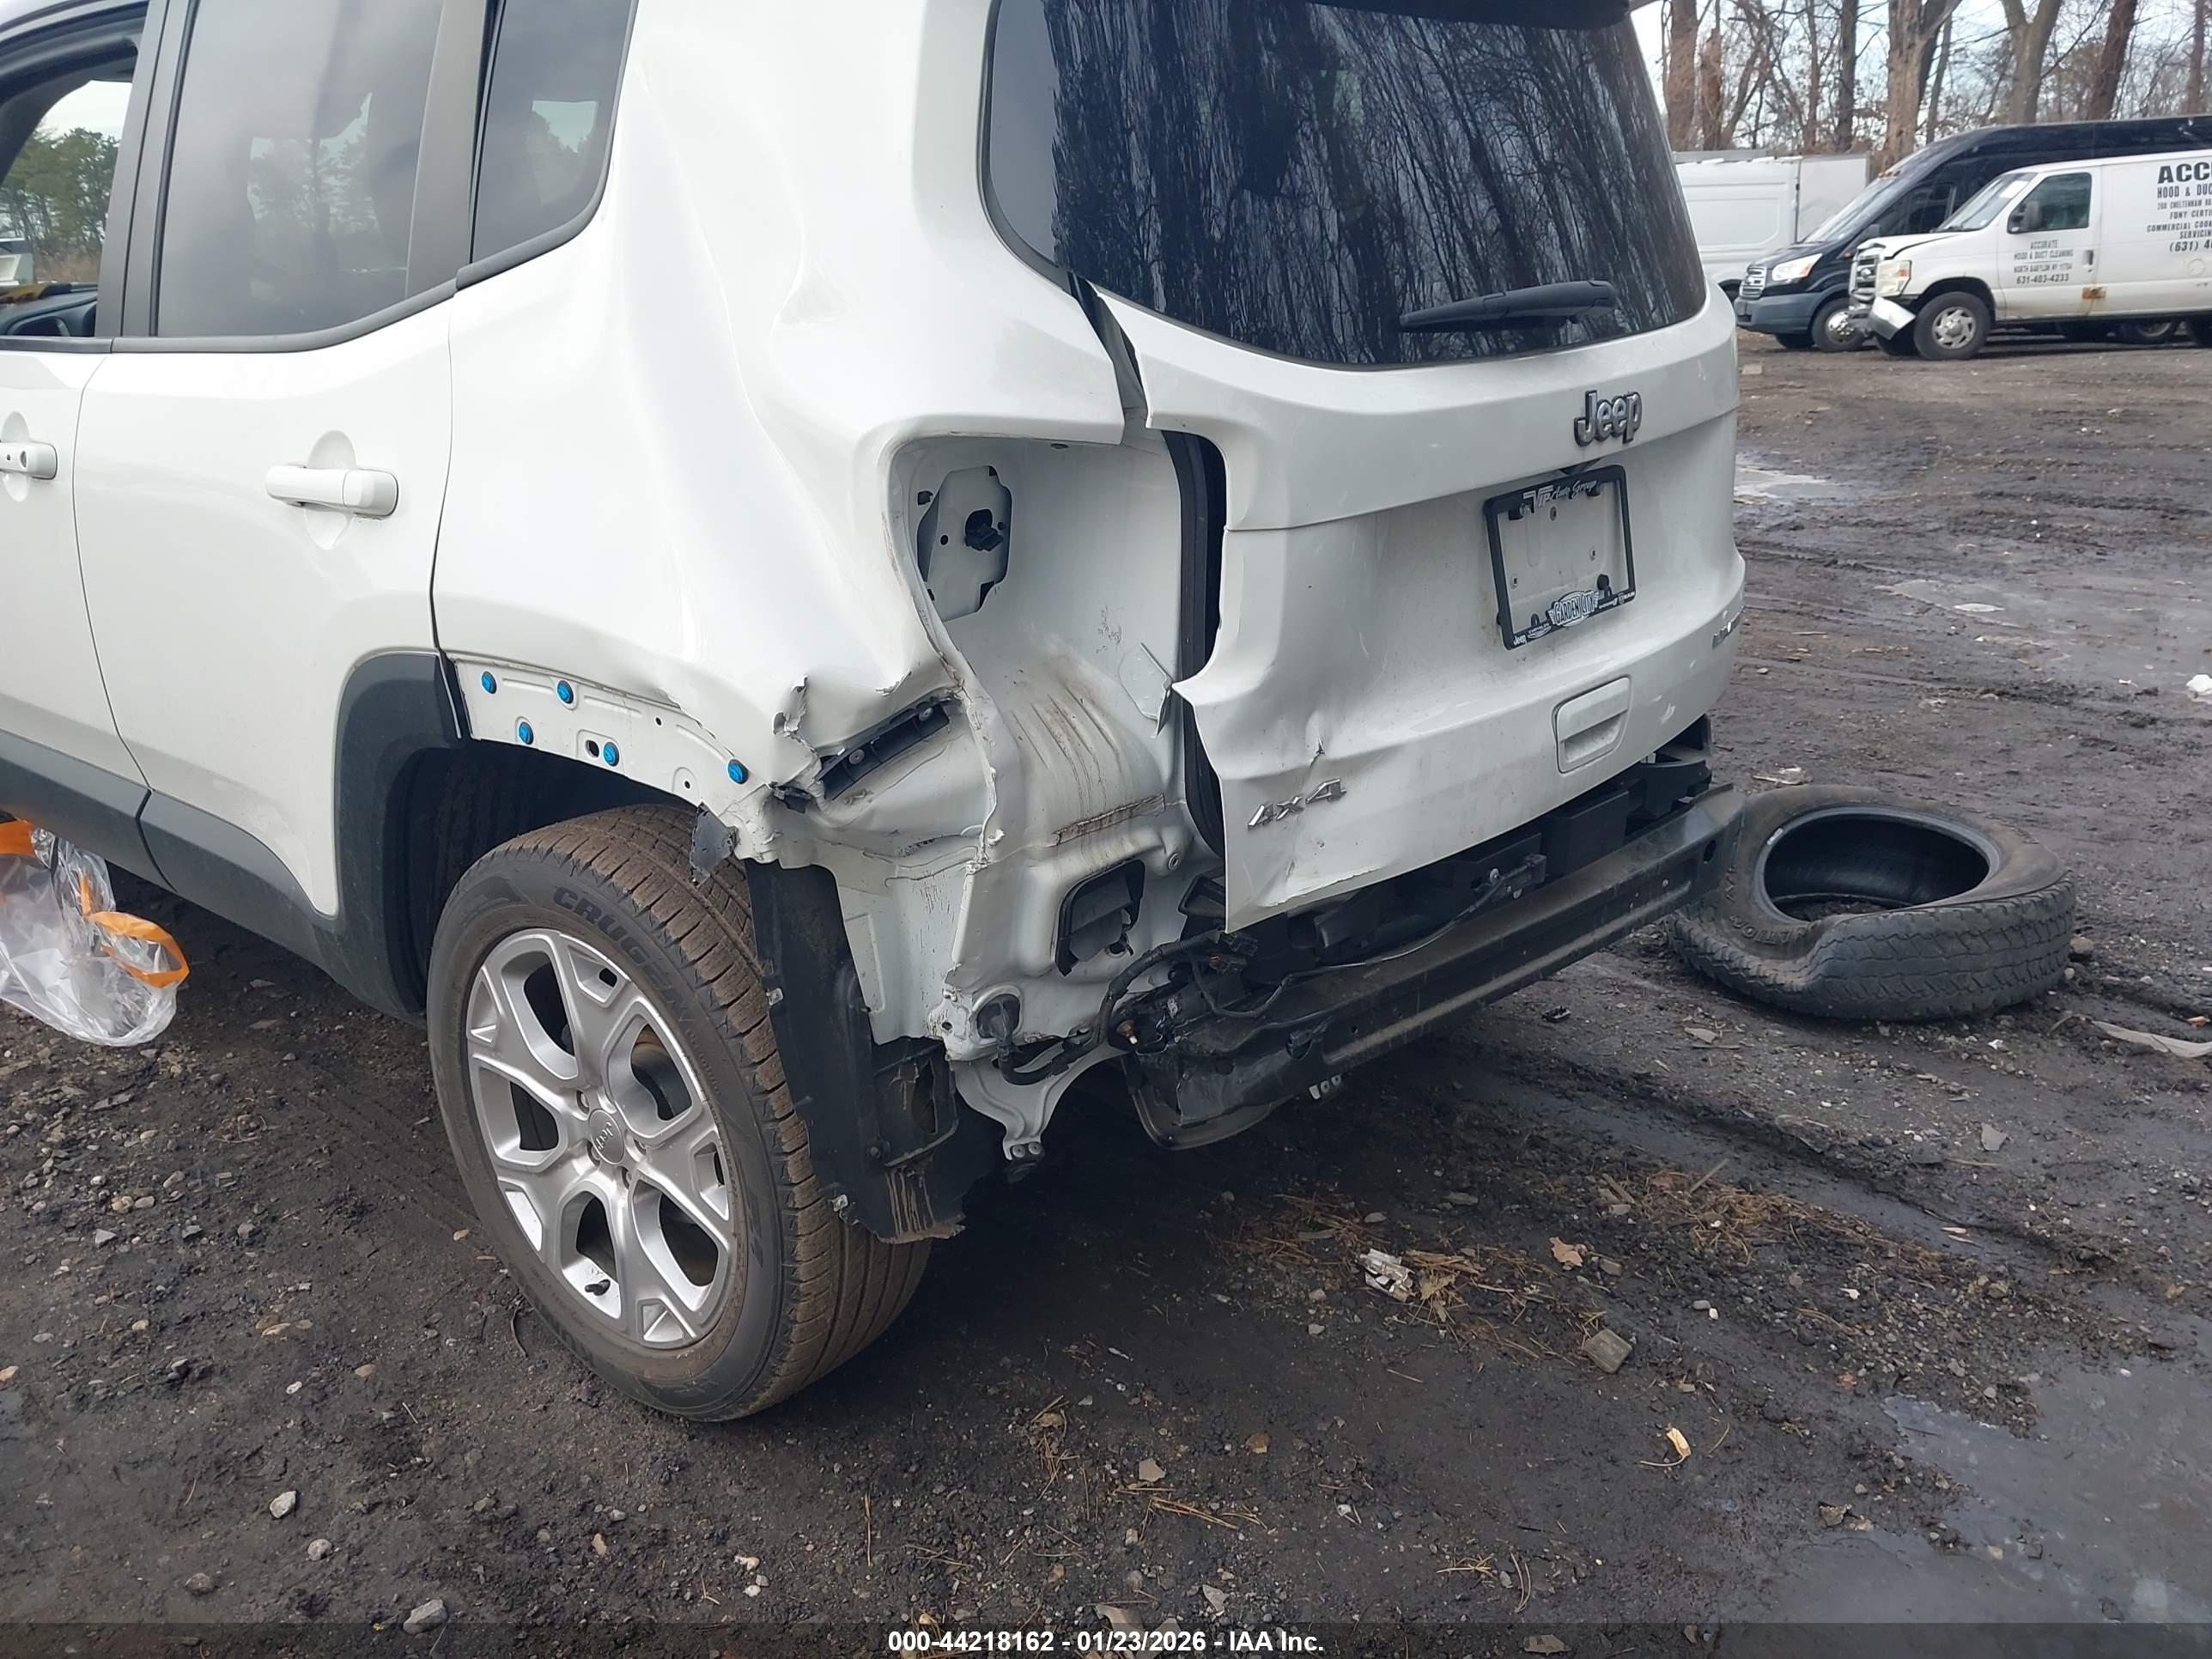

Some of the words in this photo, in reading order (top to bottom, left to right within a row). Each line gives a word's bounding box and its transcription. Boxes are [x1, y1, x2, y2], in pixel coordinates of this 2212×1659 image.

[2157, 162, 2212, 184] ACC
[2157, 185, 2179, 198] HOOD
[2185, 186, 2191, 196] &
[2147, 222, 2191, 233] COMMERCIAL
[2169, 240, 2198, 252] (631)
[2204, 239, 2212, 249] 4
[2016, 273, 2069, 284] 631-403-4233
[1574, 389, 1643, 447] Jeep
[1553, 596, 1580, 625] GARDEN
[1580, 591, 1595, 615] CITY
[1514, 635, 1528, 646] Jeep
[1248, 776, 1346, 829] 4x4
[553, 886, 697, 1023] CRUGEN
[596, 1121, 614, 1151] Jeep
